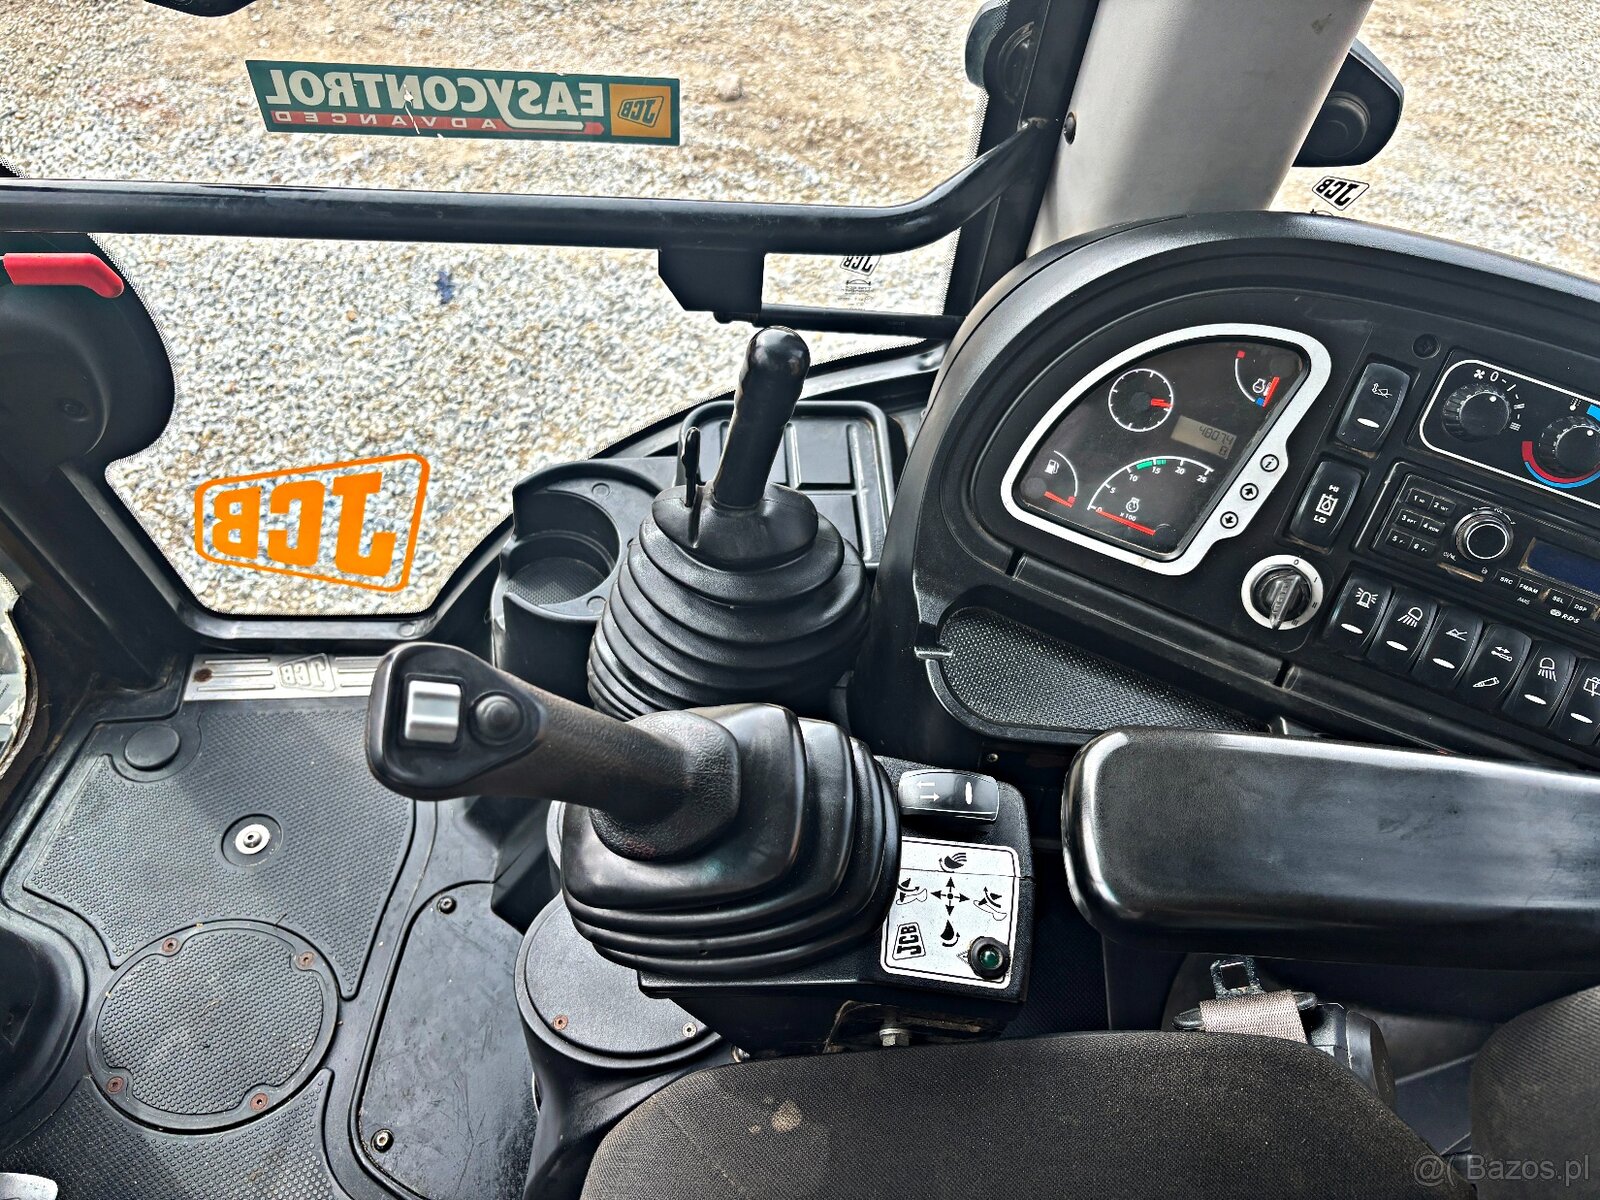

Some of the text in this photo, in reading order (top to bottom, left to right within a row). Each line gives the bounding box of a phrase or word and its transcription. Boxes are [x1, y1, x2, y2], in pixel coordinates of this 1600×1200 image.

[1152, 466, 1161, 474] 15
[1175, 466, 1185, 475] 20
[1129, 474, 1138, 482] 10
[1196, 475, 1207, 483] 25
[896, 924, 922, 957] JCB
